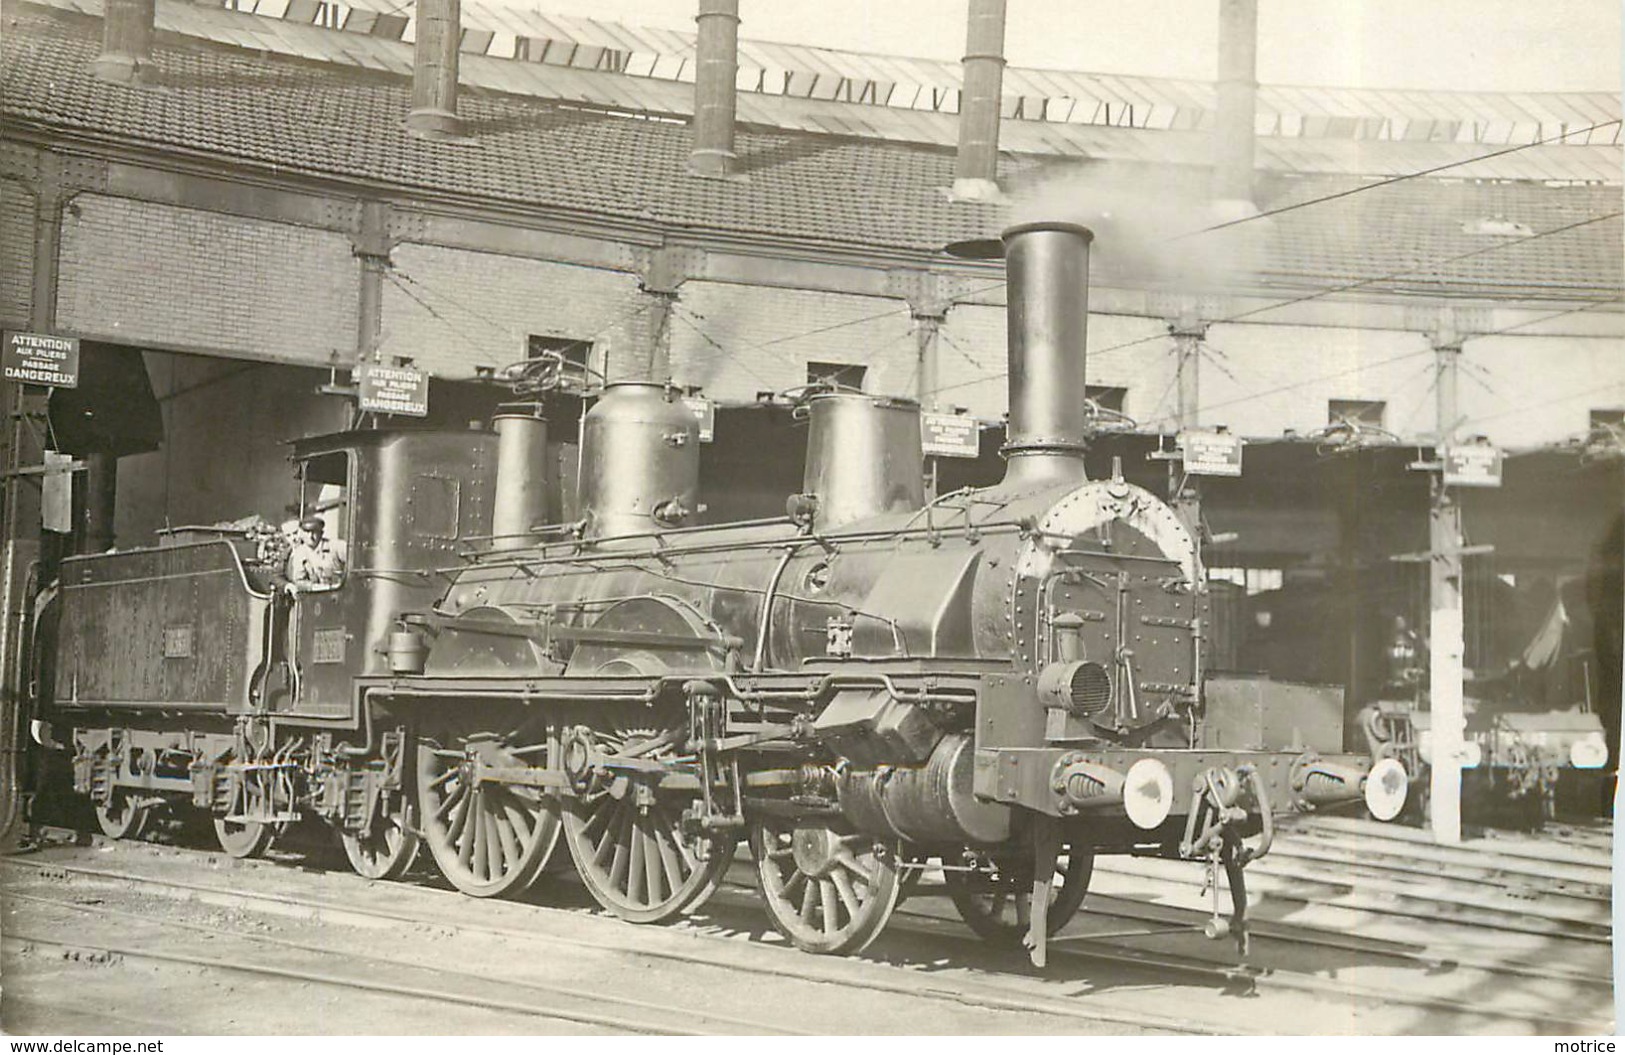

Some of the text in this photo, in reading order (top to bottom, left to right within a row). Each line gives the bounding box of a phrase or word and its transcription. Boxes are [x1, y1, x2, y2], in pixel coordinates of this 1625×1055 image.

[11, 334, 72, 351] ATTENTION
[16, 346, 67, 360] AUX PILIERS
[22, 360, 60, 371] PASSAGE
[5, 367, 75, 384] DANGEREUX
[367, 368, 422, 383] ATTENTION
[362, 397, 425, 413] DANGEREUX
